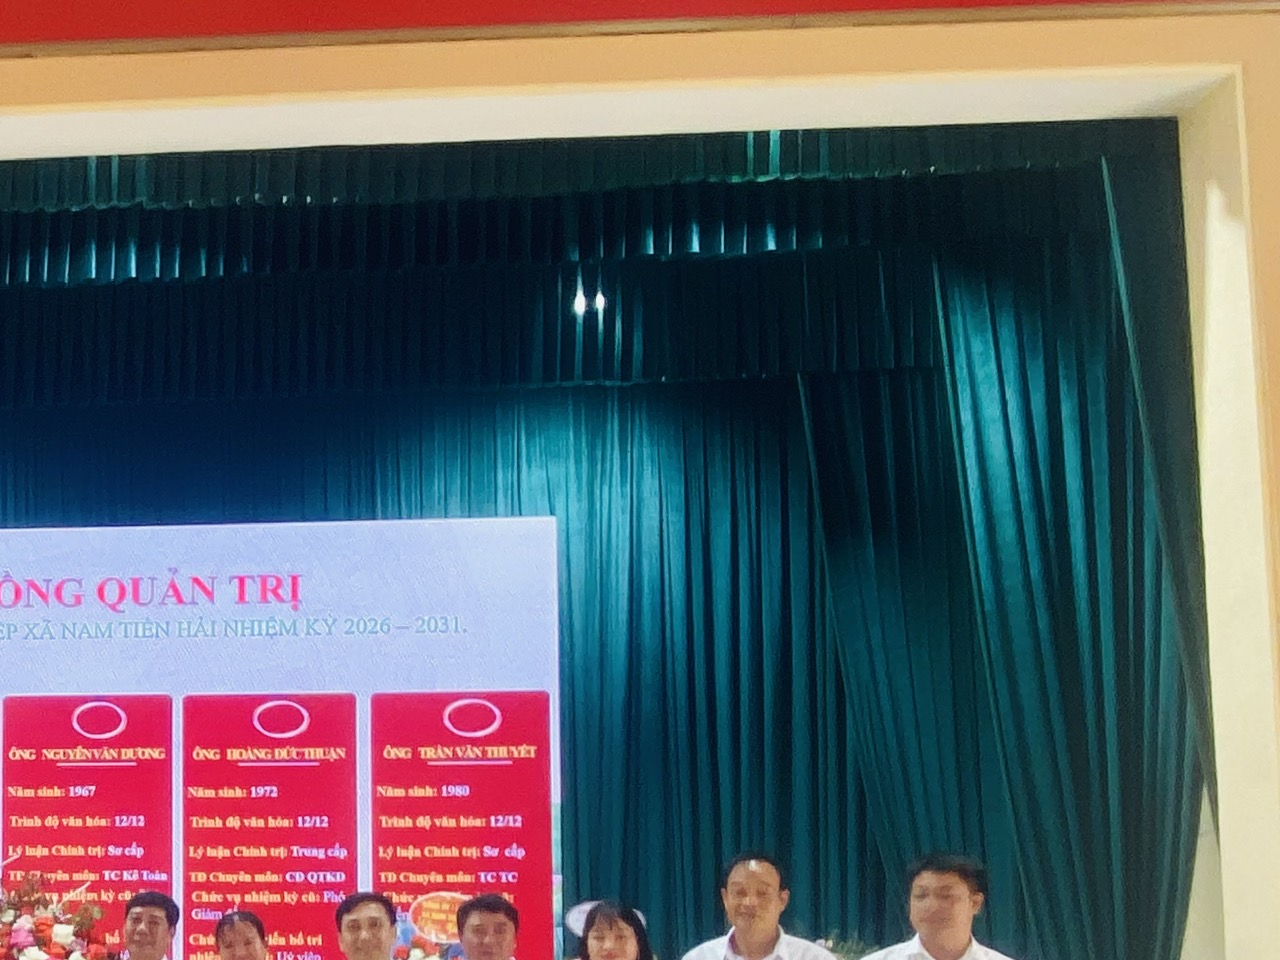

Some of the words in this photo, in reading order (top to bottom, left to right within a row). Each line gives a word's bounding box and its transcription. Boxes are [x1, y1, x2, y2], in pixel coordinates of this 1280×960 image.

[96, 567, 216, 613] QUẢN
[230, 574, 303, 612] TRỊ
[22, 619, 56, 640] XÃ
[61, 622, 113, 640] NAM
[344, 617, 390, 635] 2026
[414, 616, 467, 634] 2031.
[8, 747, 36, 760] ÔNG
[193, 746, 220, 760] ÔNG
[383, 745, 412, 759] ÔNG
[8, 786, 34, 797] Năm
[37, 786, 65, 797] sinh:
[69, 786, 96, 797] 1967
[187, 786, 215, 798] Năm
[218, 787, 246, 797] sinh:
[250, 786, 278, 797] 1972
[377, 786, 405, 797] Năm
[408, 785, 437, 797] sinh:
[441, 785, 470, 796] 1980
[45, 816, 59, 829] độ
[62, 817, 82, 827] văn
[114, 816, 144, 827] 12/12
[226, 816, 240, 829] độ
[244, 817, 264, 827] văn
[297, 816, 329, 827] 12/12
[416, 816, 431, 830] độ
[434, 817, 456, 827] văn
[490, 816, 522, 827] 12/12
[52, 845, 84, 856] Chính
[108, 845, 122, 856] Sơ
[125, 842, 144, 858] cấp
[233, 846, 267, 857] Chính
[290, 846, 325, 859] Trung
[327, 843, 347, 859] cấp
[424, 846, 459, 857] Chính
[483, 846, 499, 857] Sơ
[505, 843, 525, 859] cấp
[102, 871, 120, 881] TC
[141, 870, 167, 881] Toán
[210, 872, 251, 884] Chuyên
[307, 872, 345, 884] QTKD
[399, 872, 443, 885] Chuyên
[478, 872, 497, 882] TC
[499, 872, 518, 882] TC
[226, 894, 240, 905] vụ
[244, 892, 281, 905] nhiệm
